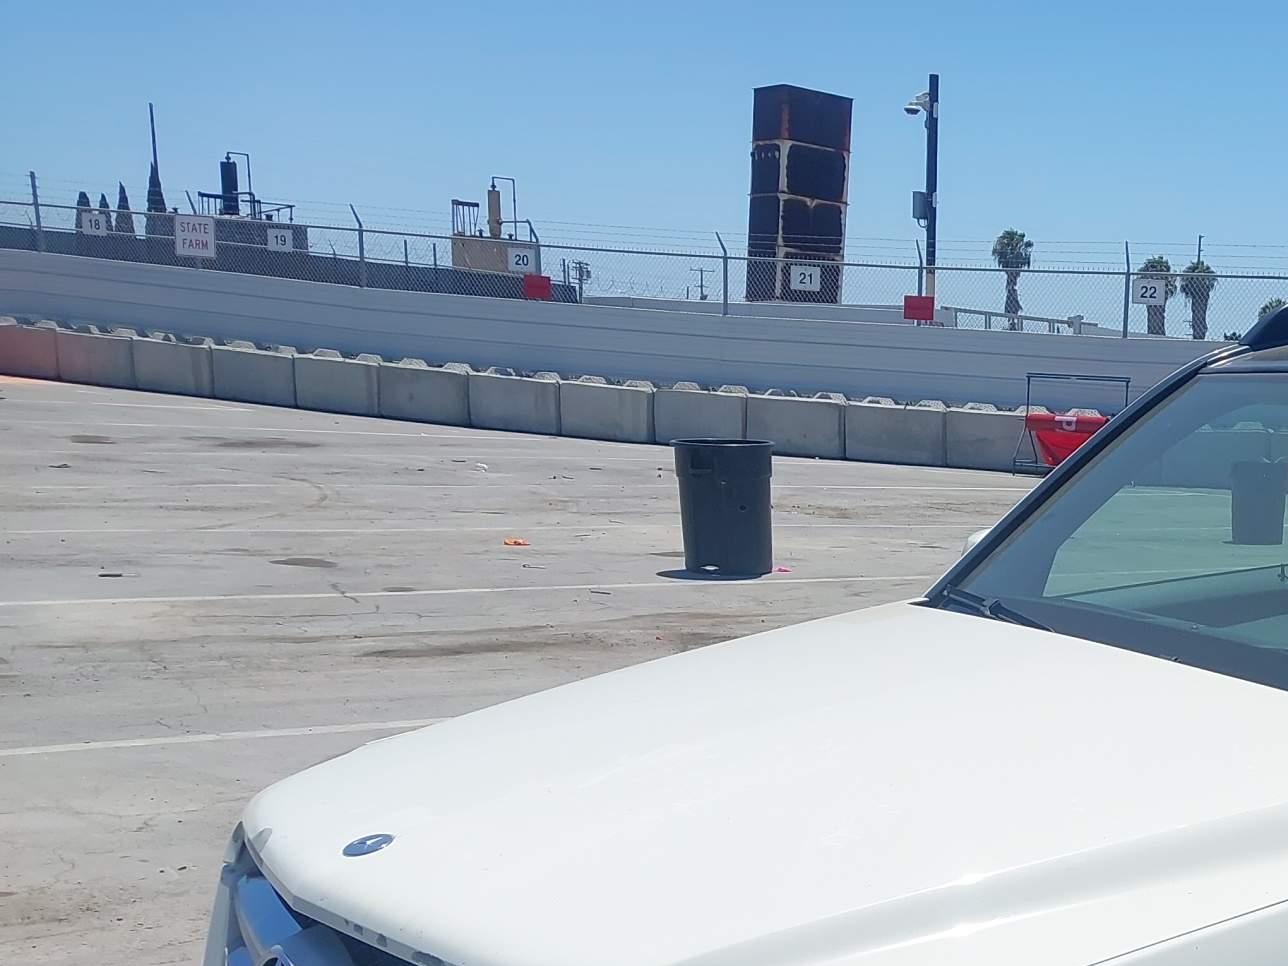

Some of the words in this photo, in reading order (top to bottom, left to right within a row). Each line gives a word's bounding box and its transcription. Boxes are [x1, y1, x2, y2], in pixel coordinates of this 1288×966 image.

[88, 219, 101, 231] 18
[180, 221, 209, 234] STATE
[182, 238, 209, 251] FARM
[274, 234, 287, 247] 19
[514, 254, 529, 266] 20
[799, 271, 813, 285] 21
[1140, 285, 1157, 299] 22
